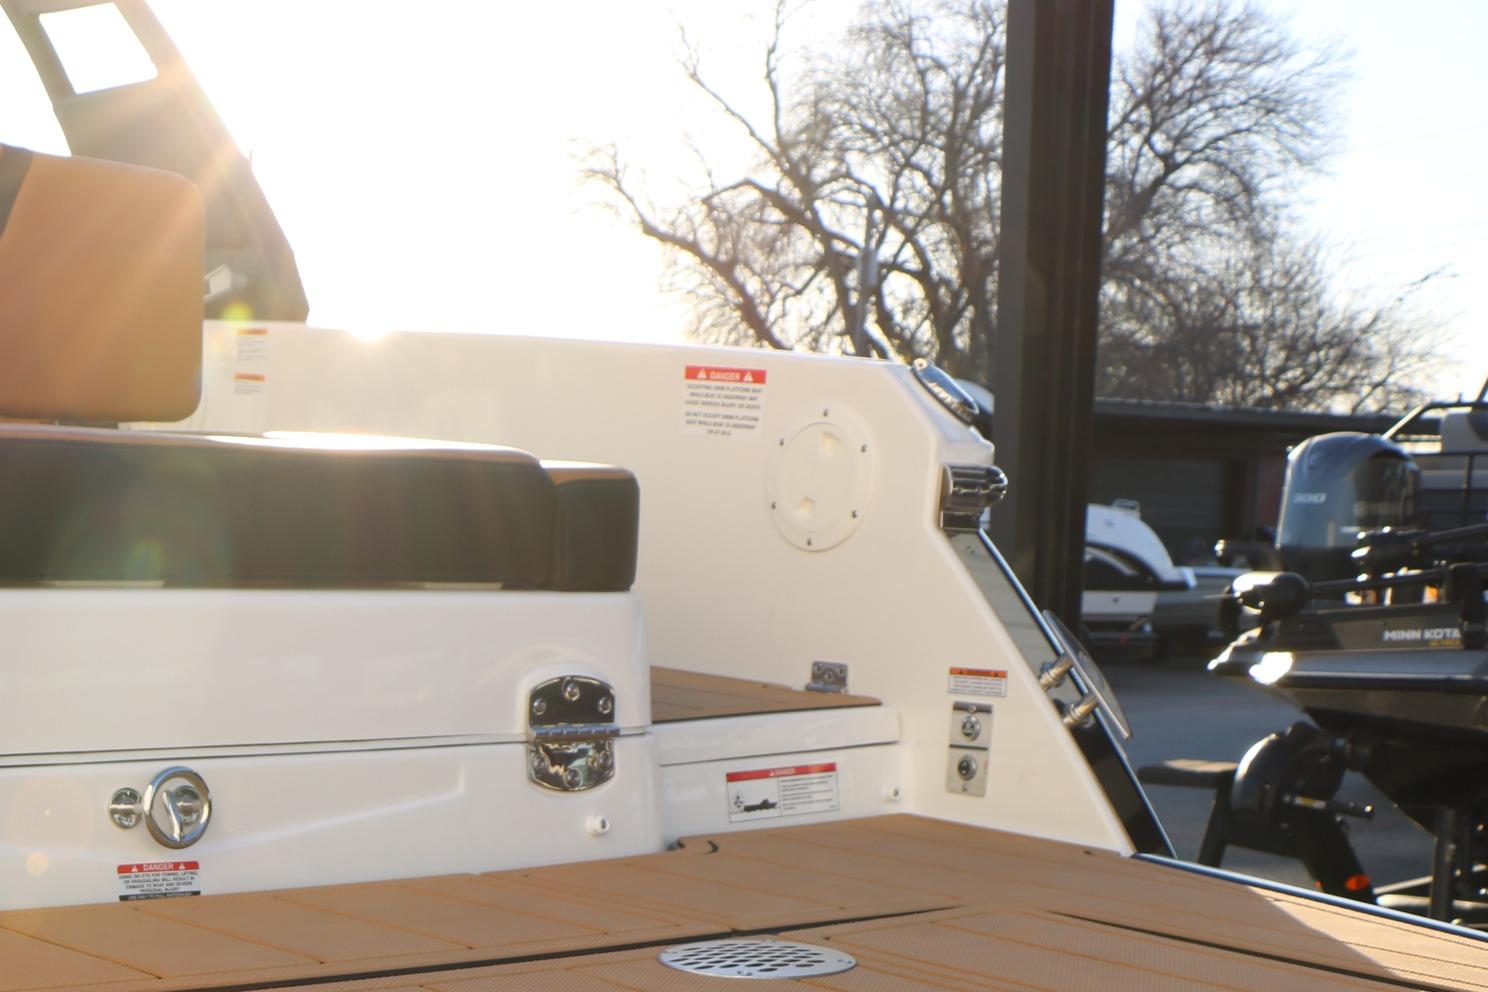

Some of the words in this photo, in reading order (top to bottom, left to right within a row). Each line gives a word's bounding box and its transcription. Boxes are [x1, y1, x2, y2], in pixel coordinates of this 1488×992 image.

[1383, 629, 1421, 641] MINN
[1424, 627, 1461, 639] KOTA
[143, 862, 174, 871] DANGER
